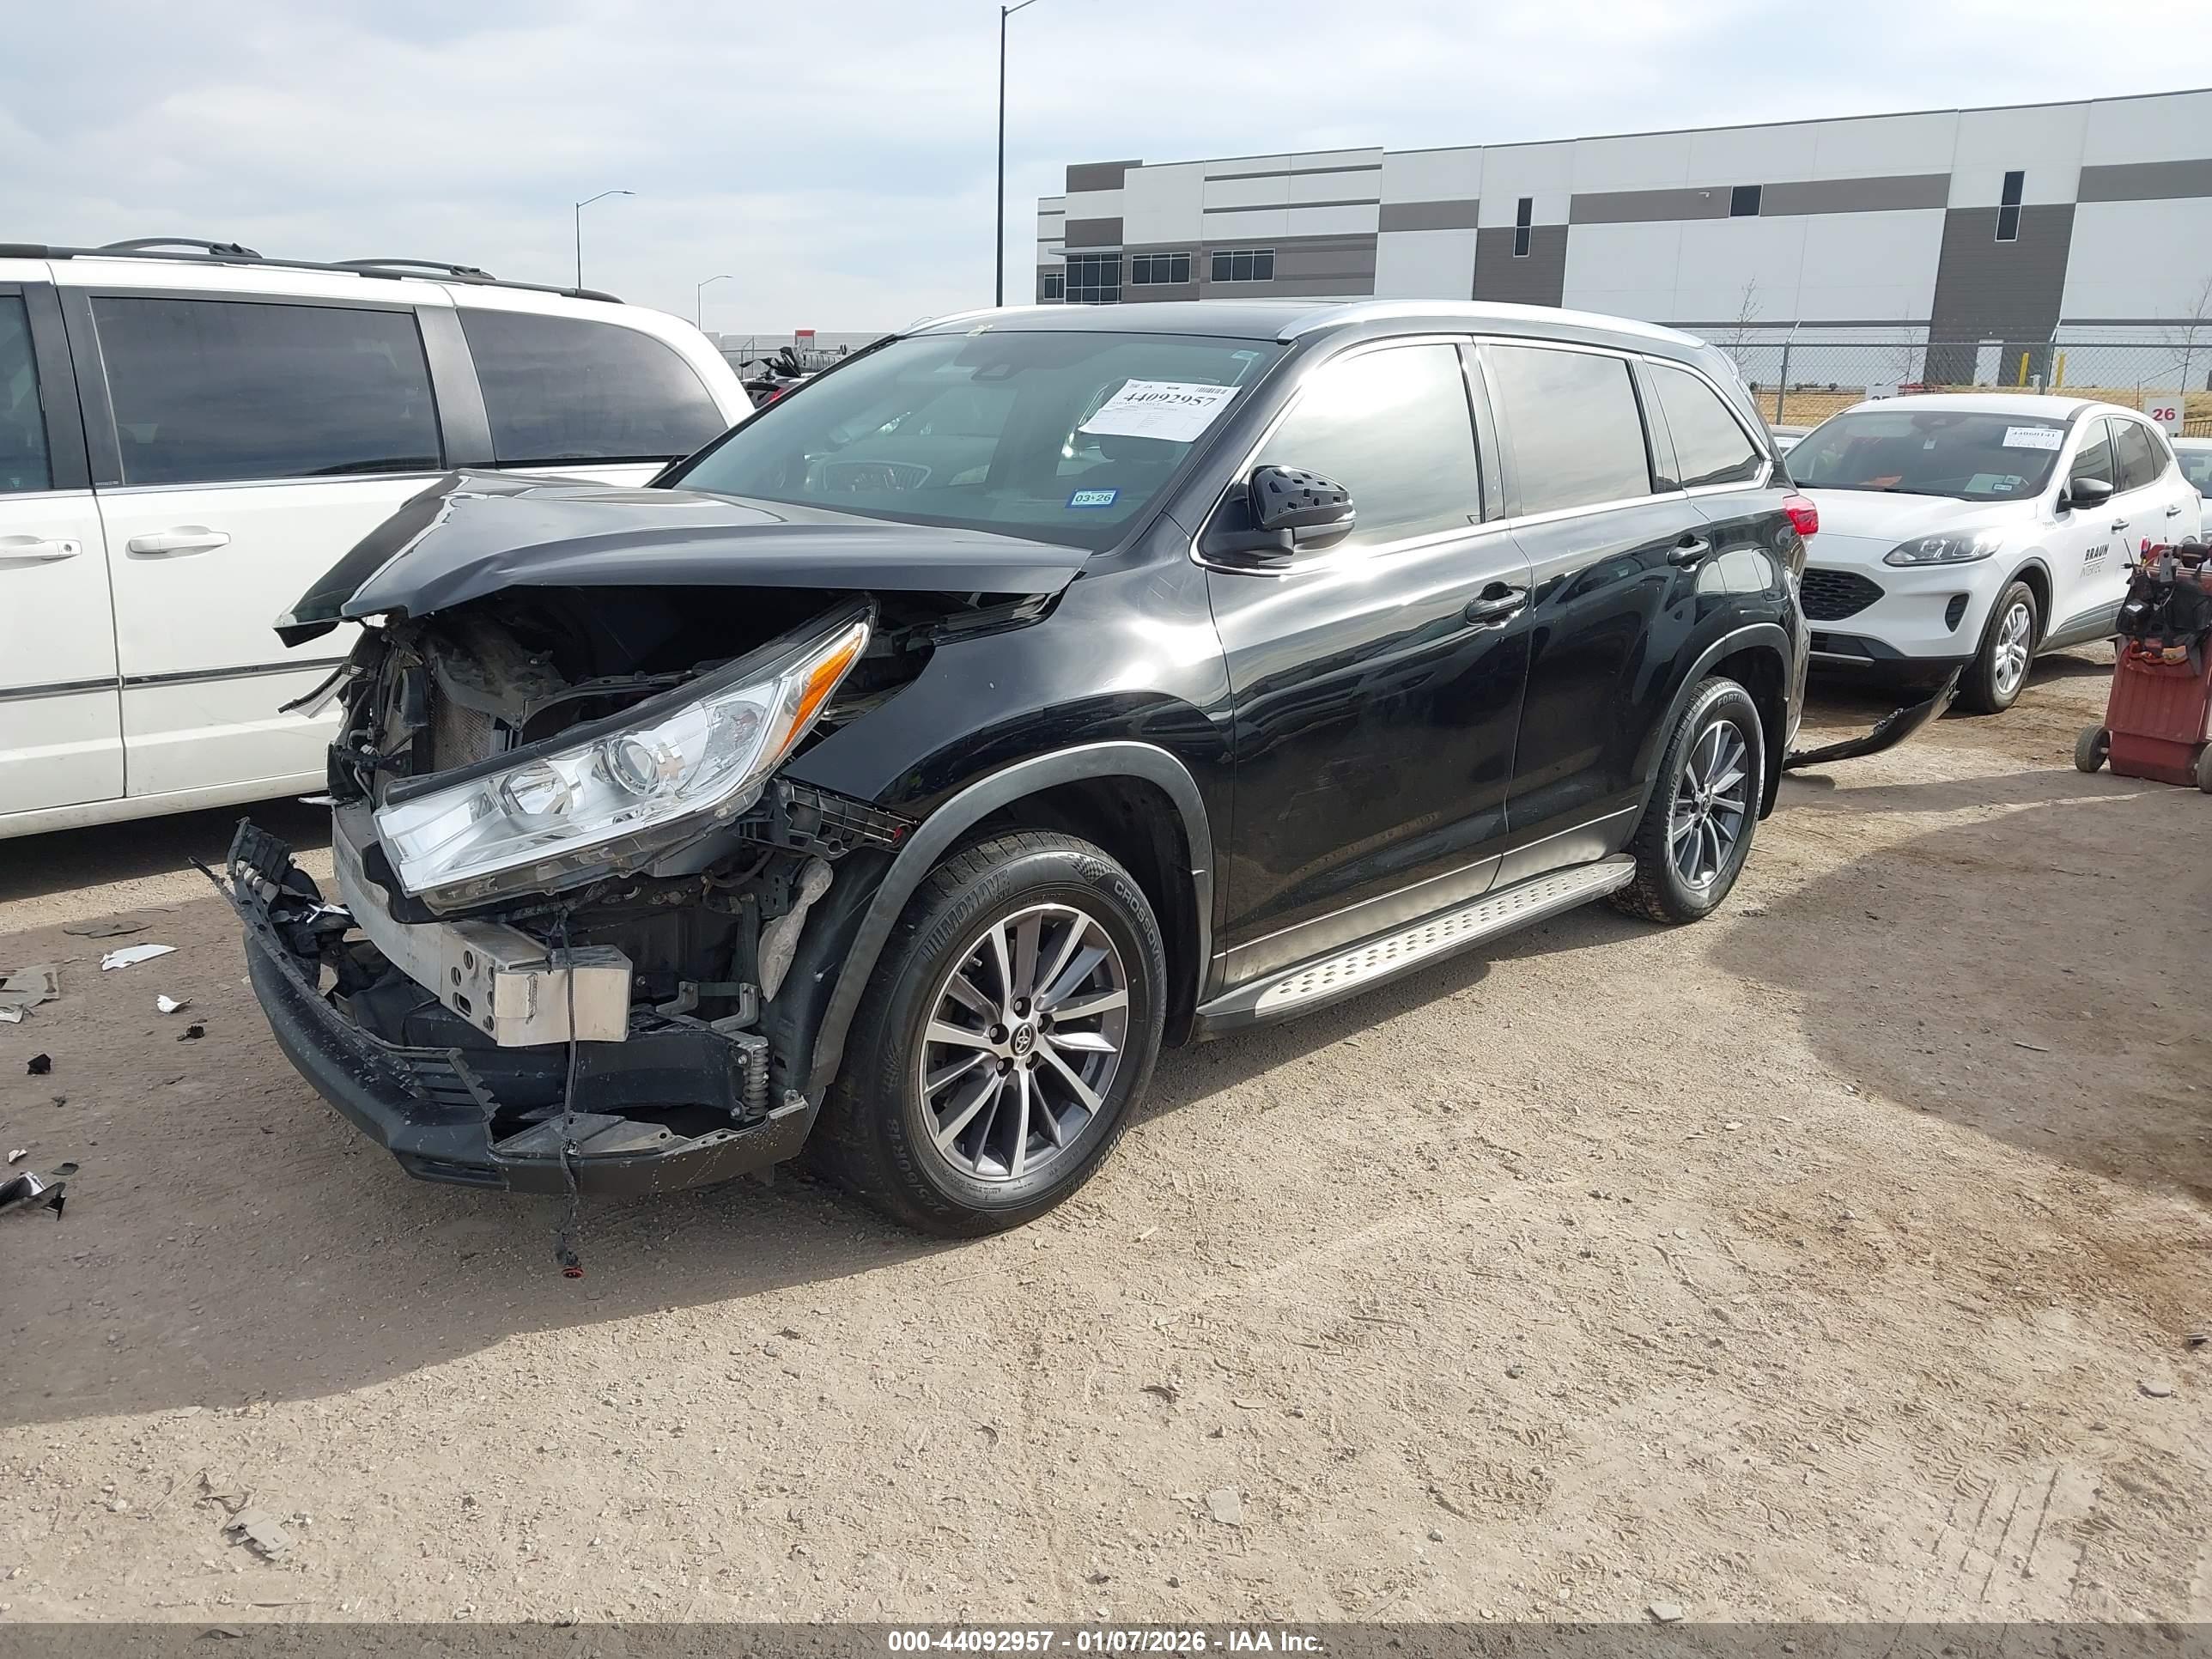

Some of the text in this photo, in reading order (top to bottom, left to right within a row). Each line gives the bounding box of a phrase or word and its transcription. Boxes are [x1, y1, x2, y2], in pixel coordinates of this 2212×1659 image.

[1123, 392, 1218, 407] 44092957
[2152, 407, 2176, 422] 26
[2084, 543, 2110, 562] BRAUN
[1114, 879, 1164, 983] CROSSOVER
